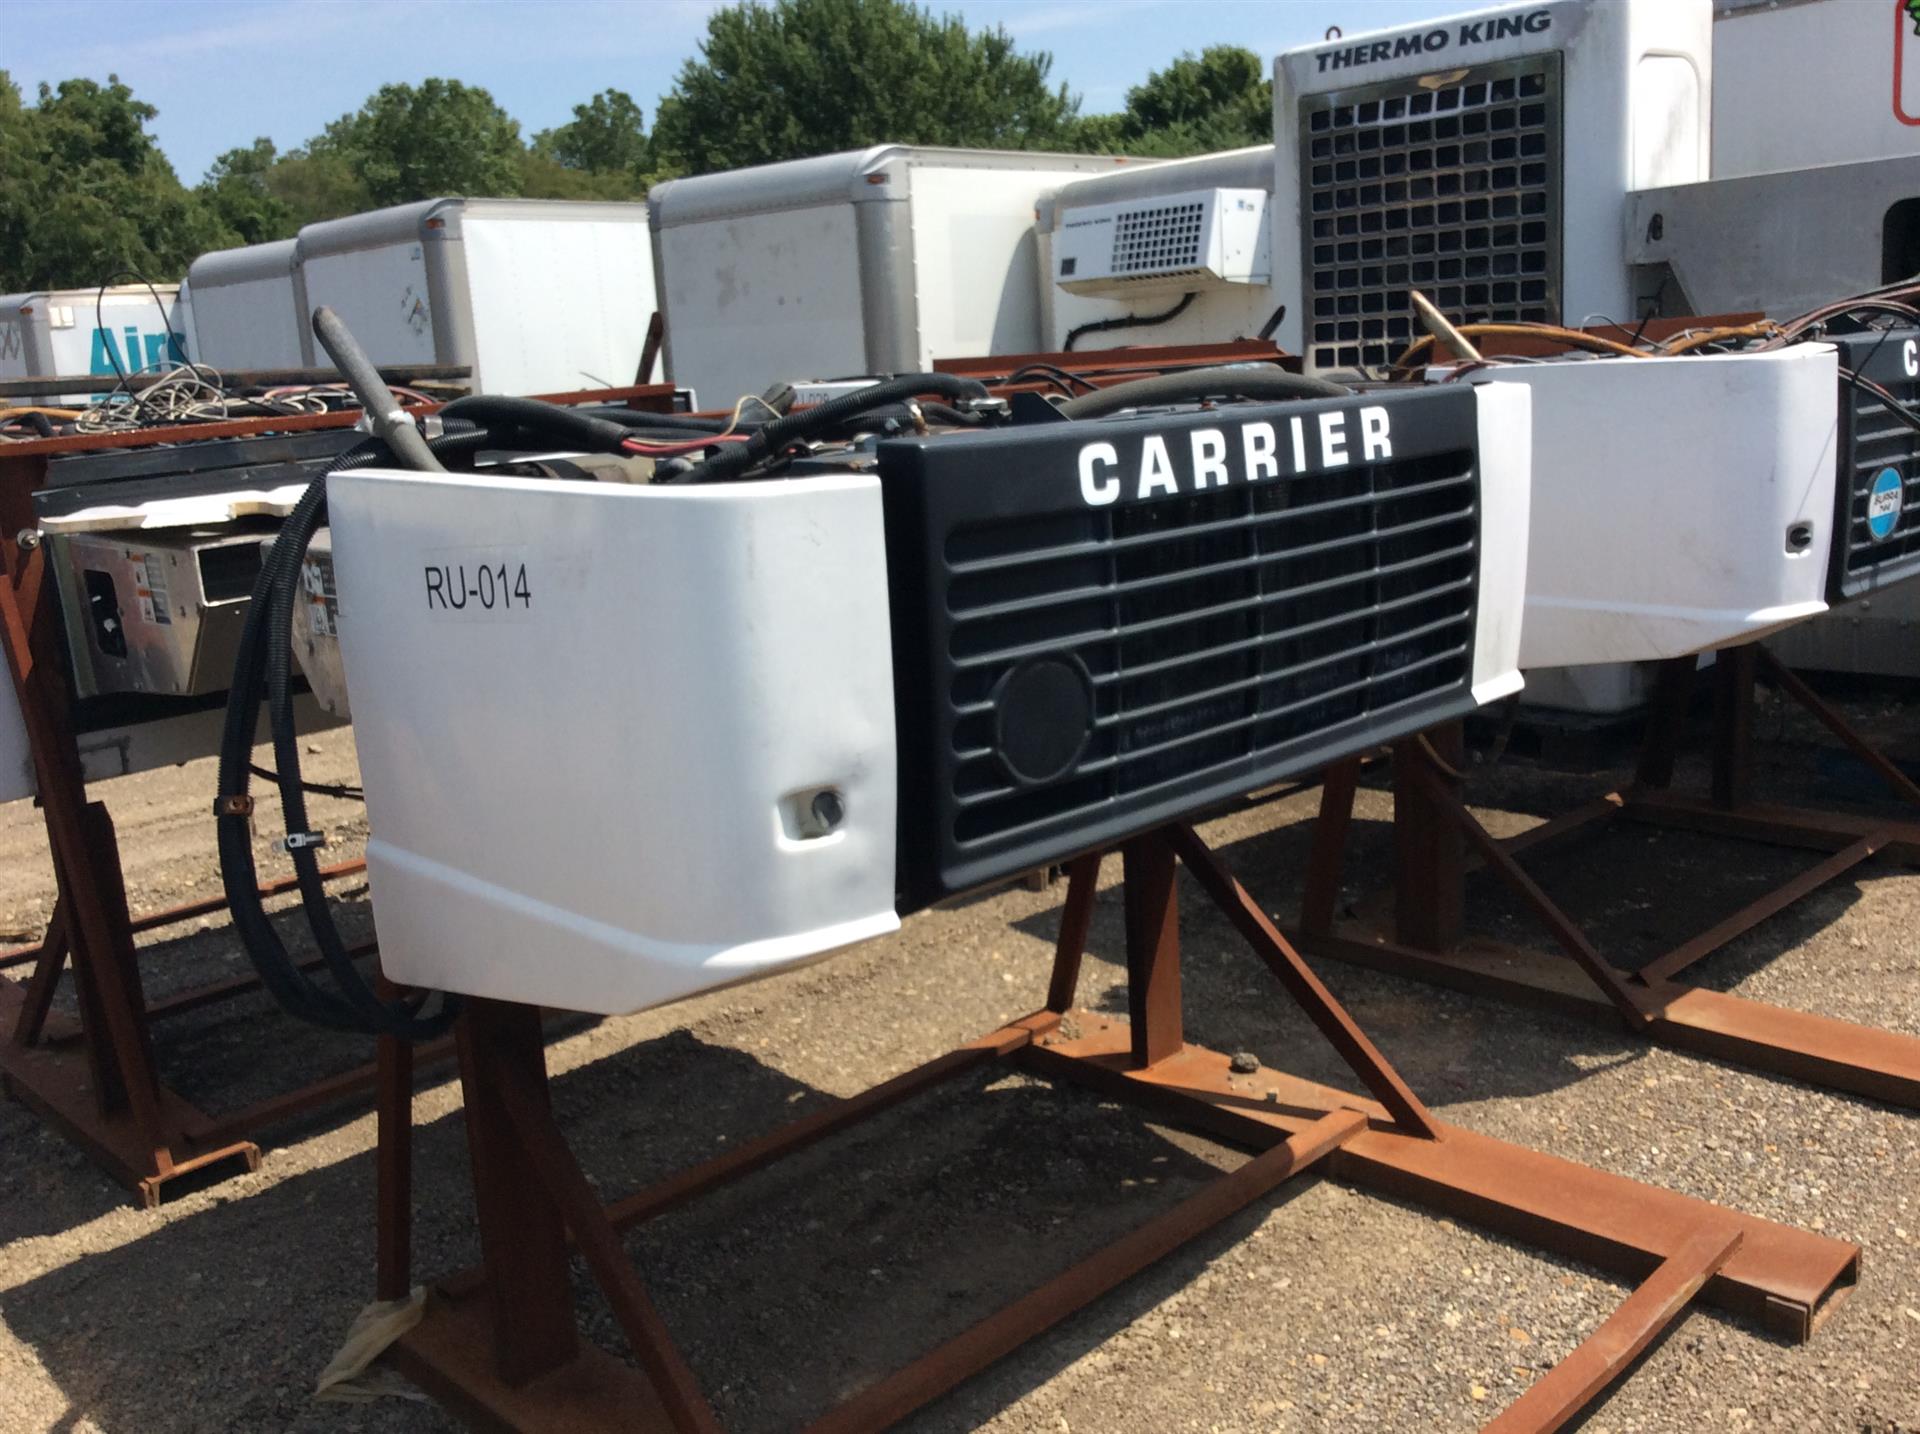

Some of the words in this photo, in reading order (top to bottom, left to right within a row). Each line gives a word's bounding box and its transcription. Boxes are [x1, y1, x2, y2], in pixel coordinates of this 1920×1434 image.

[1315, 30, 1449, 73] THERMO
[1459, 10, 1552, 46] KING
[1077, 405, 1393, 506] CARRIER
[425, 563, 531, 609] RU-014
